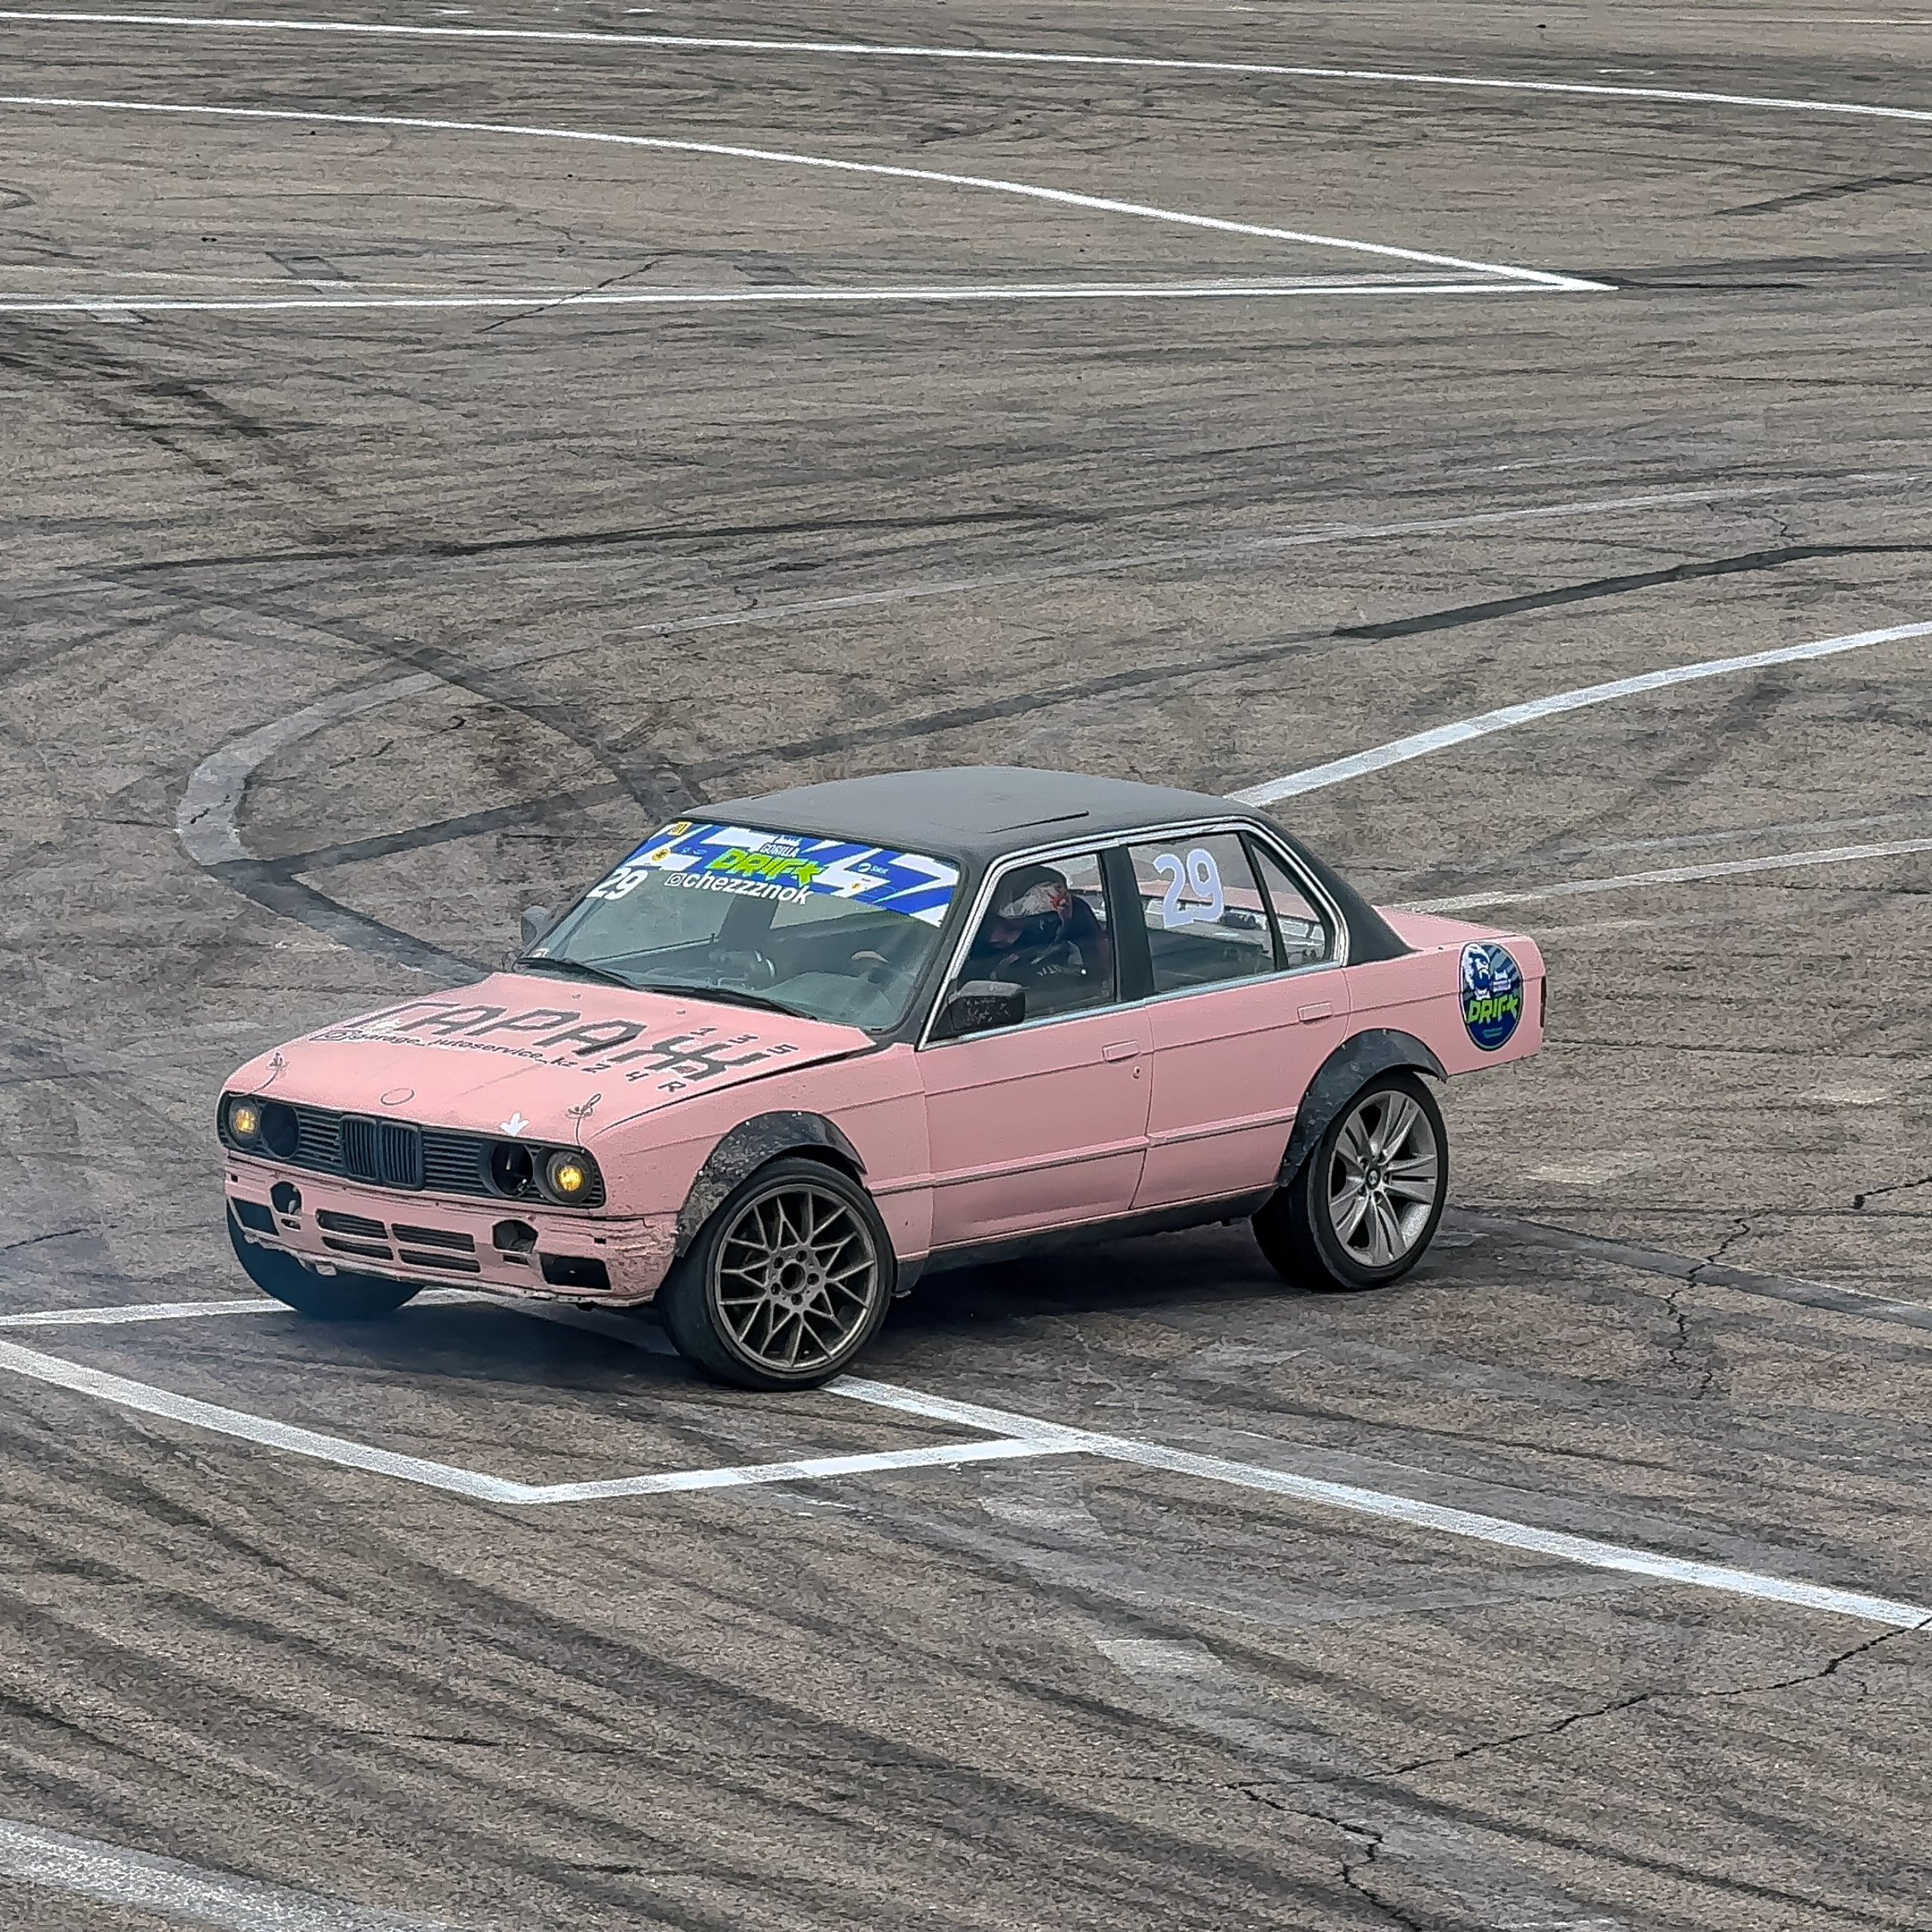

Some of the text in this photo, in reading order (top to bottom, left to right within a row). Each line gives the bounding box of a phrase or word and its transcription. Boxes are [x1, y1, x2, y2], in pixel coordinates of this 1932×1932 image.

[704, 847, 825, 888] DRIFT
[761, 843, 801, 857] GORILLA
[586, 867, 648, 900] 29
[1152, 848, 1224, 929] 29
